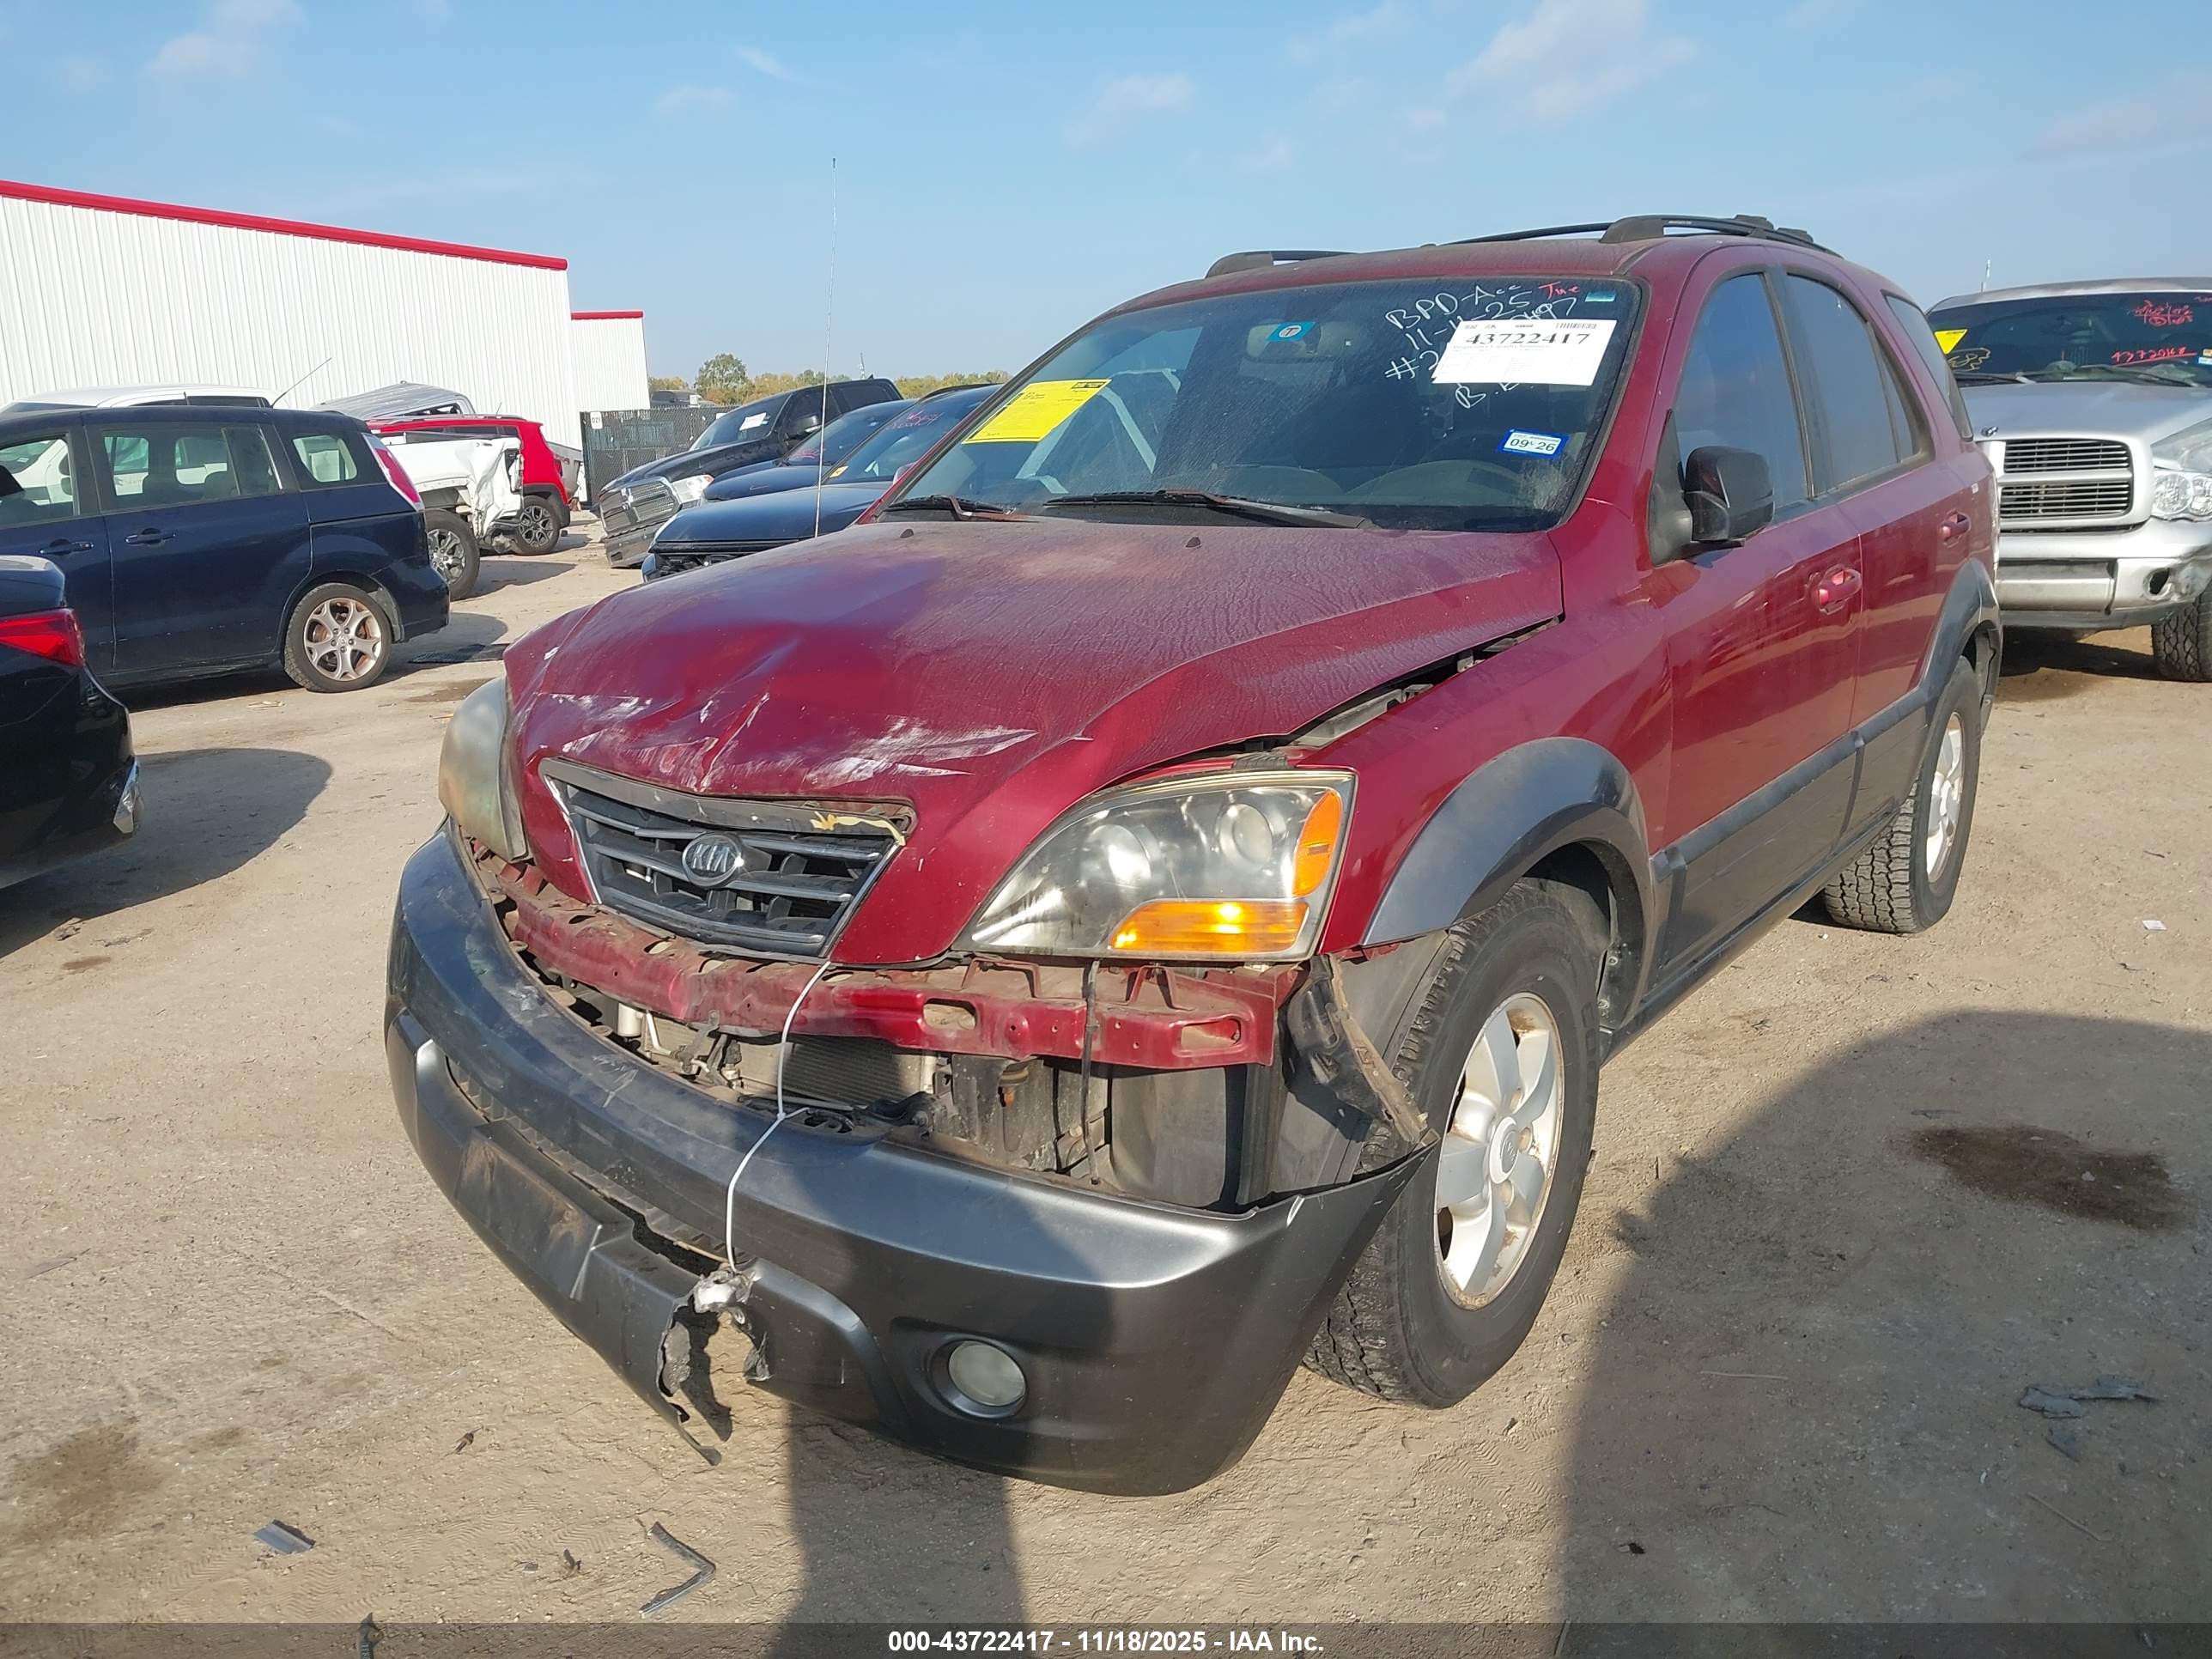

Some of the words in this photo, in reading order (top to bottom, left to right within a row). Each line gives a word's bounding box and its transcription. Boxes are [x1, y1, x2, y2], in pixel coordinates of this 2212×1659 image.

[1466, 332, 1589, 344] 43722417
[1510, 438, 1529, 448] 09
[1535, 441, 1556, 452] 26
[691, 843, 730, 873] KIA
